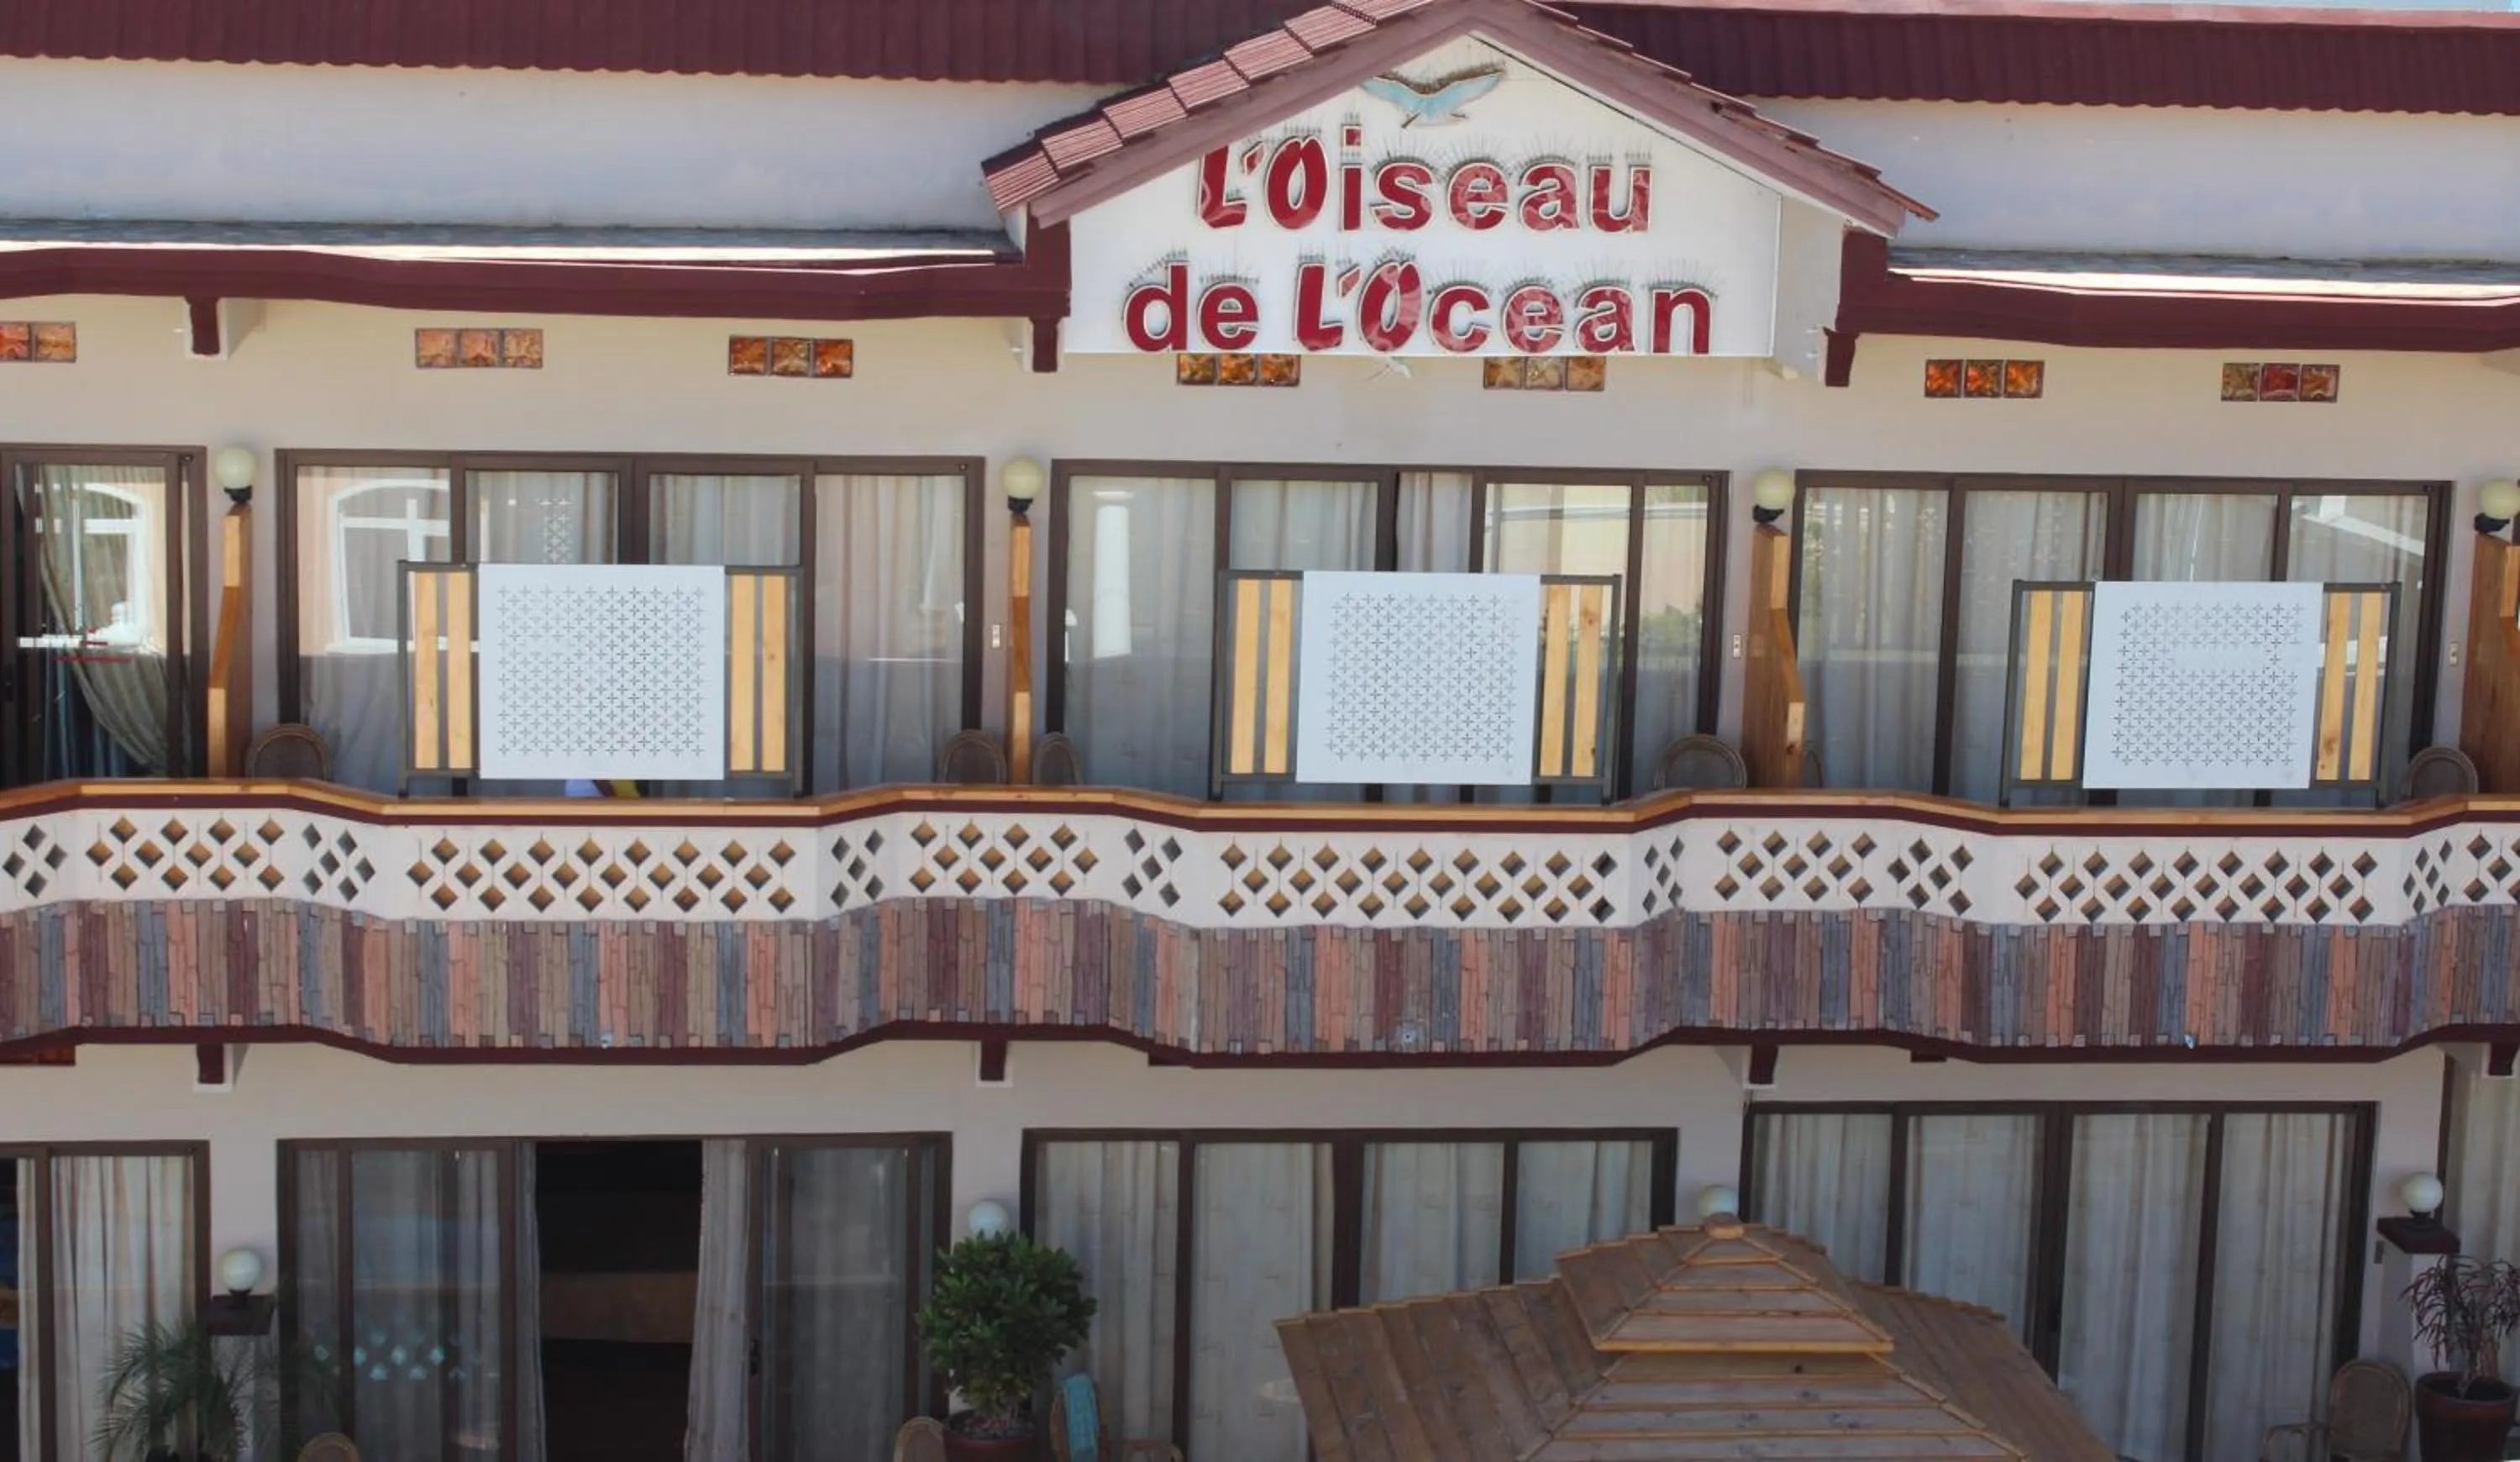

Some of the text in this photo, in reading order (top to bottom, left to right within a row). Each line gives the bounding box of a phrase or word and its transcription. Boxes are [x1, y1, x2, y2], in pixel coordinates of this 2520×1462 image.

[1197, 125, 1652, 232] L'Oiseau
[1123, 260, 1711, 354] de L'Ocean
